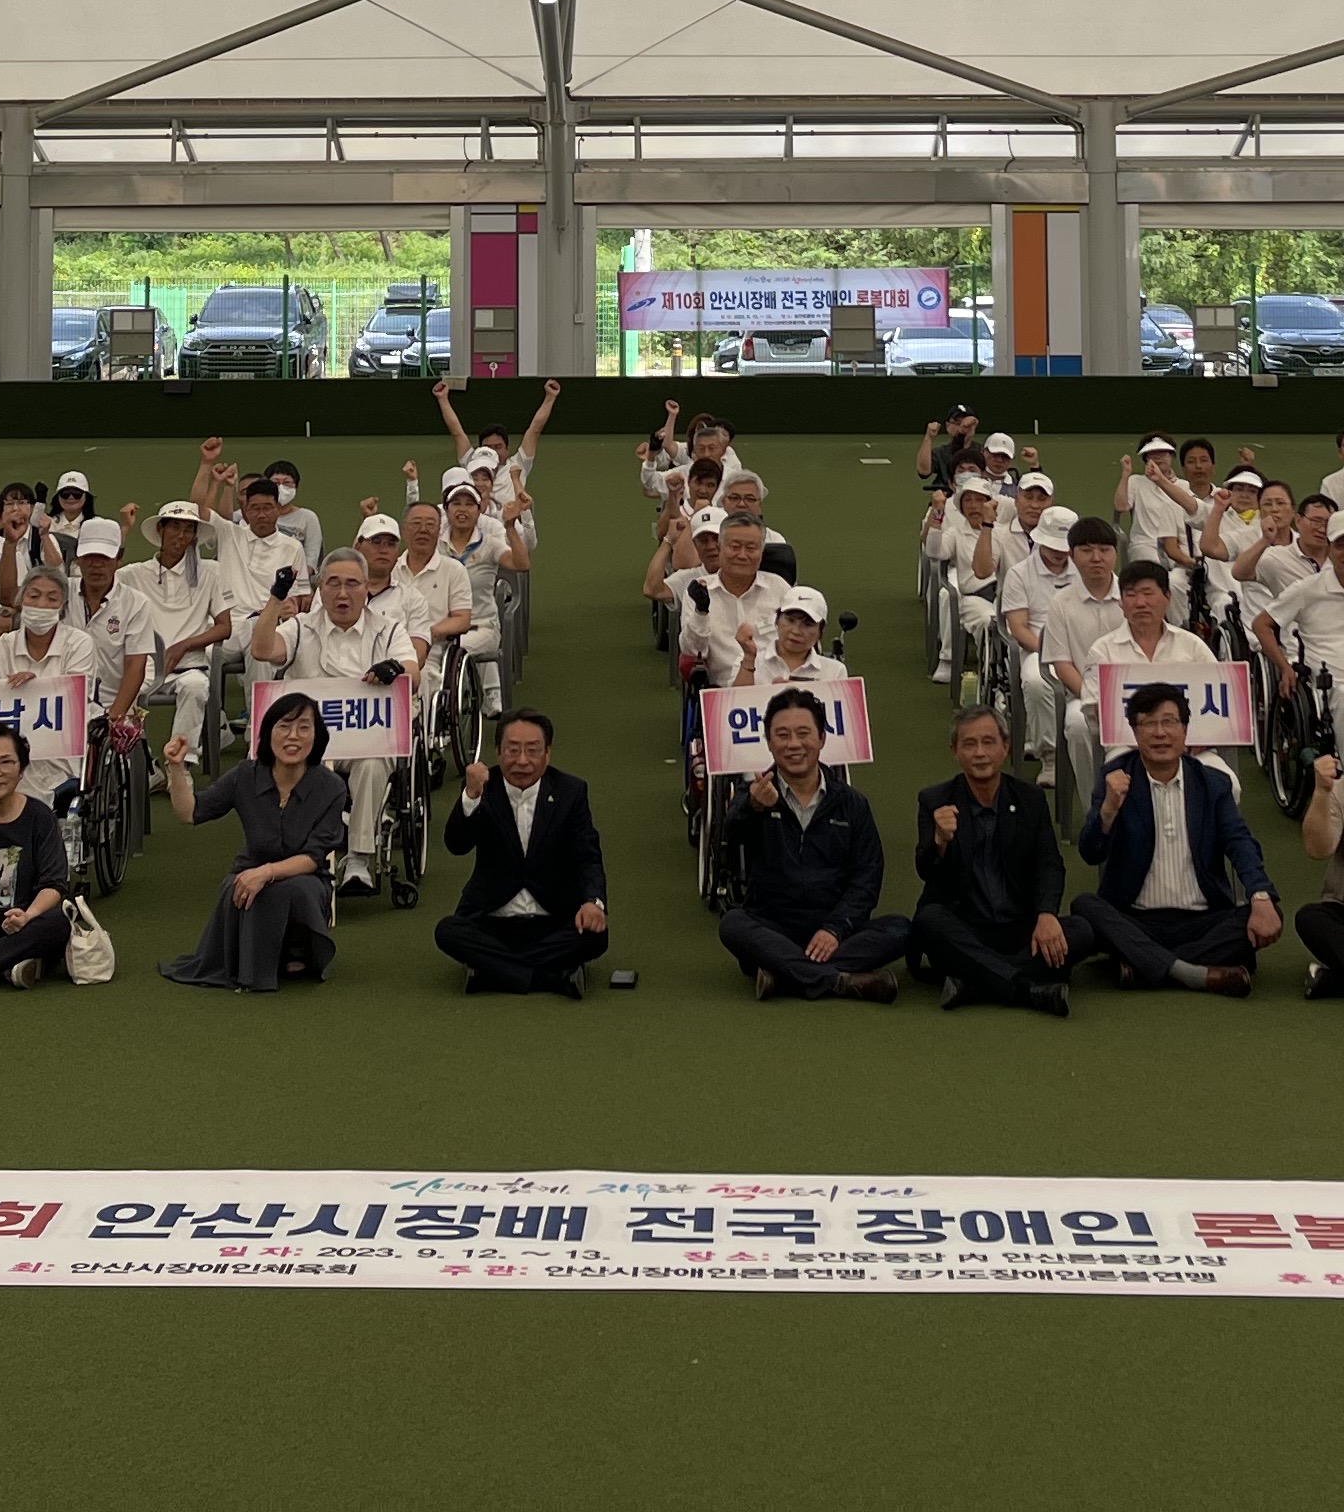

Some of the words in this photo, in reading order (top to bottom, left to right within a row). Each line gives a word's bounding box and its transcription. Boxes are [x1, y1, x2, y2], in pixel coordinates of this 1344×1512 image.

[660, 291, 705, 311] 제10회
[709, 291, 777, 311] 안산시장배
[780, 291, 808, 311] 전국
[811, 291, 852, 310] 장애인
[321, 696, 392, 731] 특례시
[728, 699, 845, 745] 안시
[87, 1201, 589, 1244] 안산시장배
[625, 1206, 822, 1246] 전국
[856, 1208, 1160, 1248] 장애인
[316, 1246, 403, 1259] 2023.
[417, 1247, 446, 1260] 9.
[461, 1247, 507, 1260] 12.
[565, 1249, 611, 1261] 13.
[69, 1261, 358, 1276] 안산시장애인체육회
